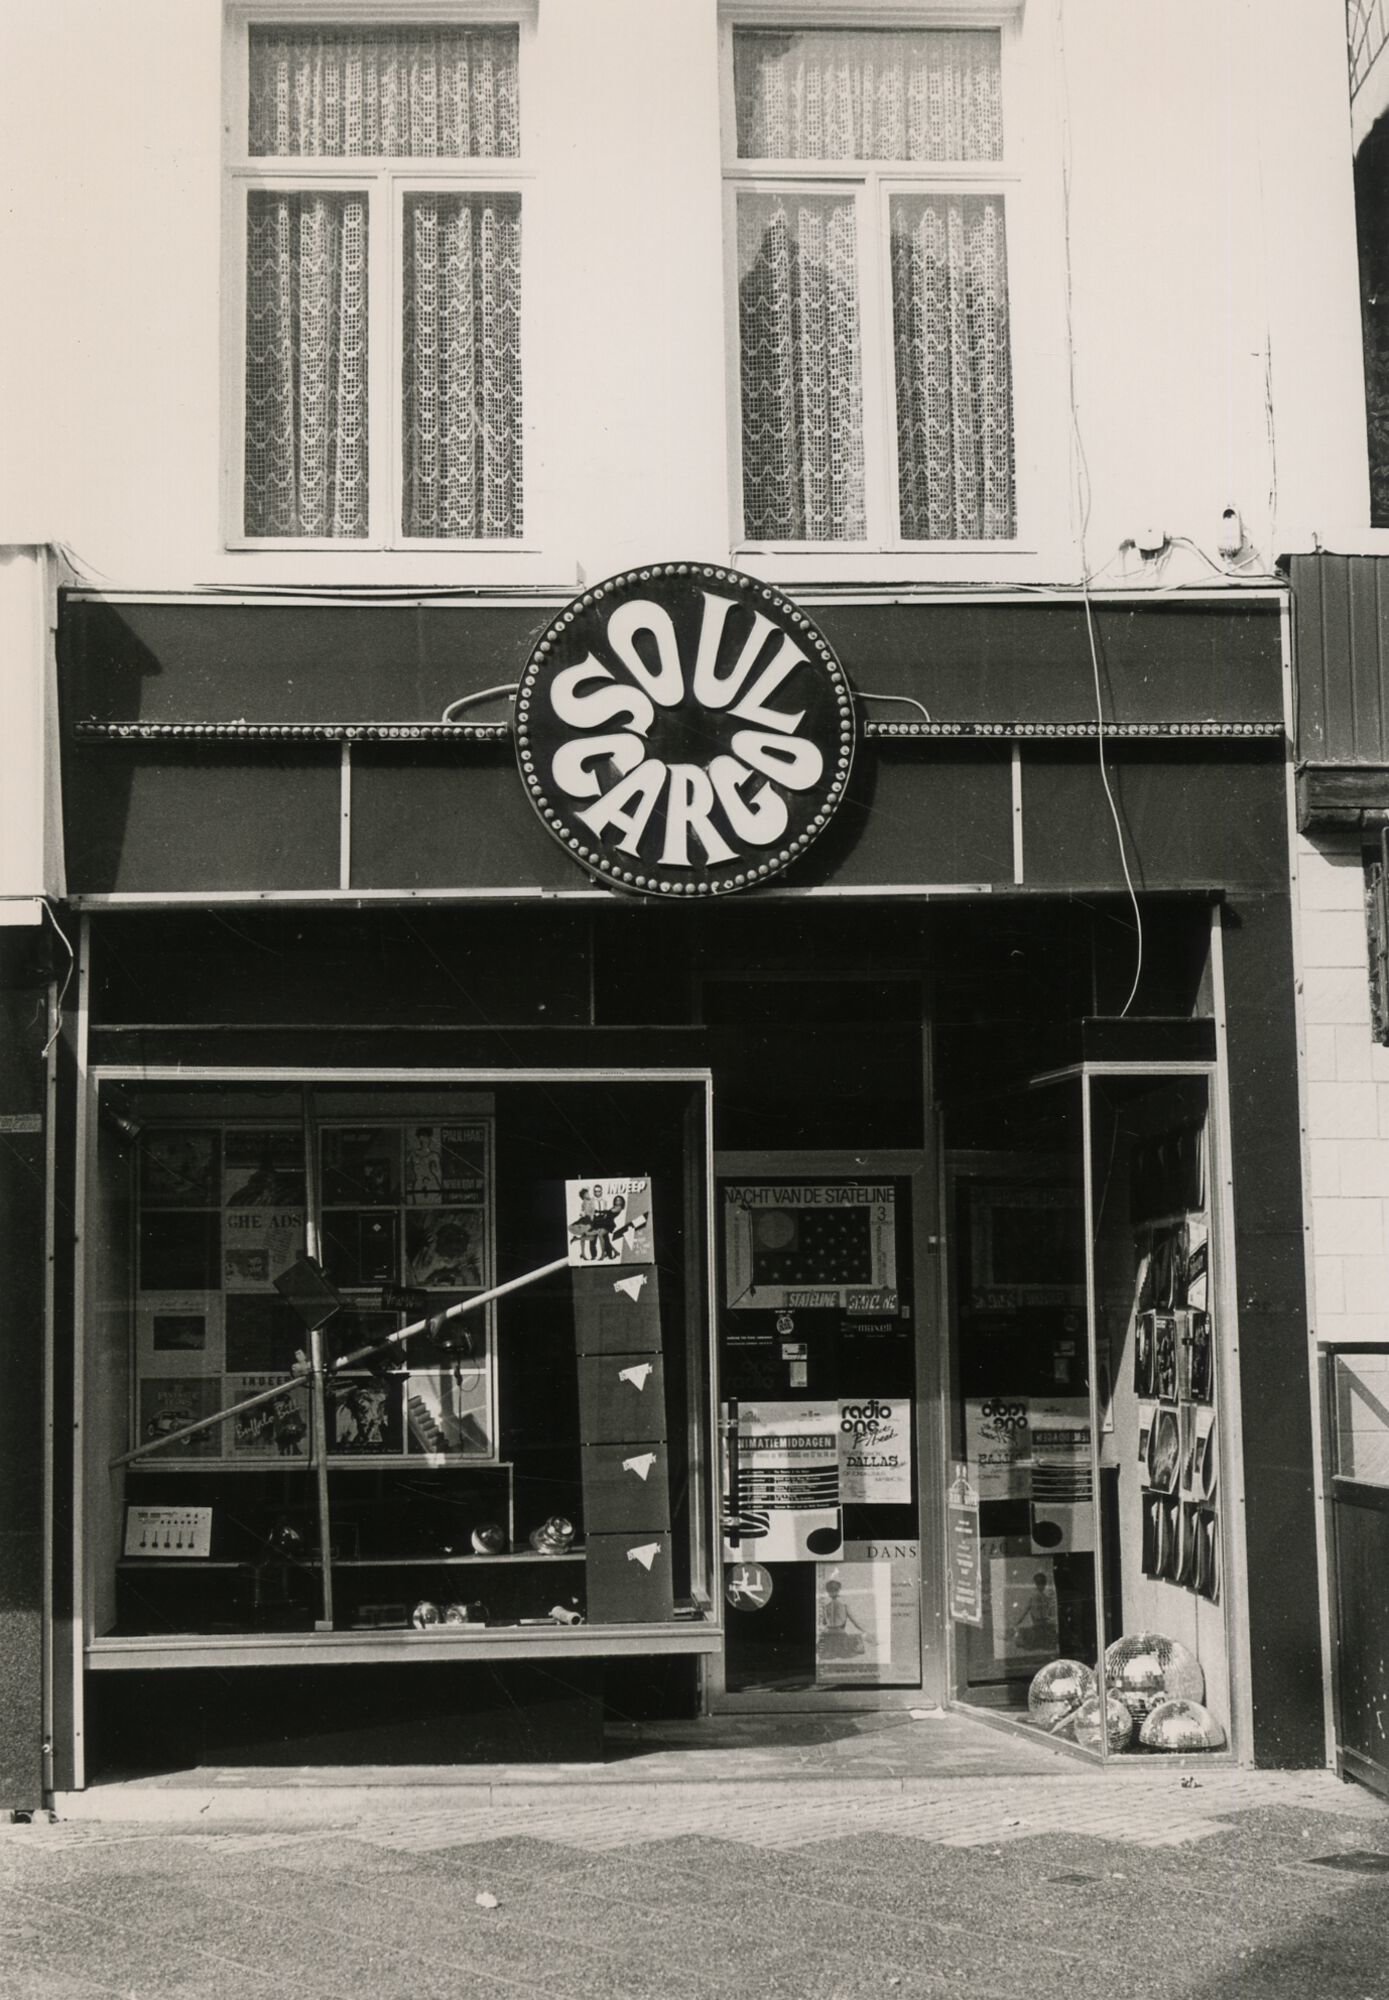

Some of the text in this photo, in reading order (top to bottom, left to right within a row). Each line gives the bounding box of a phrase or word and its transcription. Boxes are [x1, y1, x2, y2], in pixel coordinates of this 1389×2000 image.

[550, 591, 811, 738] SOUL
[552, 729, 823, 867] CARGO
[606, 1180, 648, 1194] INDEEP
[725, 1187, 895, 1203] NACHT VAN DE STATELINE
[877, 1206, 887, 1222] 3
[842, 1400, 892, 1419] radio
[235, 1398, 302, 1440] Buffalo Bill
[841, 1420, 880, 1433] one
[737, 1436, 832, 1449] NIMATIEMIDDAGEN
[846, 1455, 899, 1468] DALLAS
[866, 1546, 917, 1559] DANS
